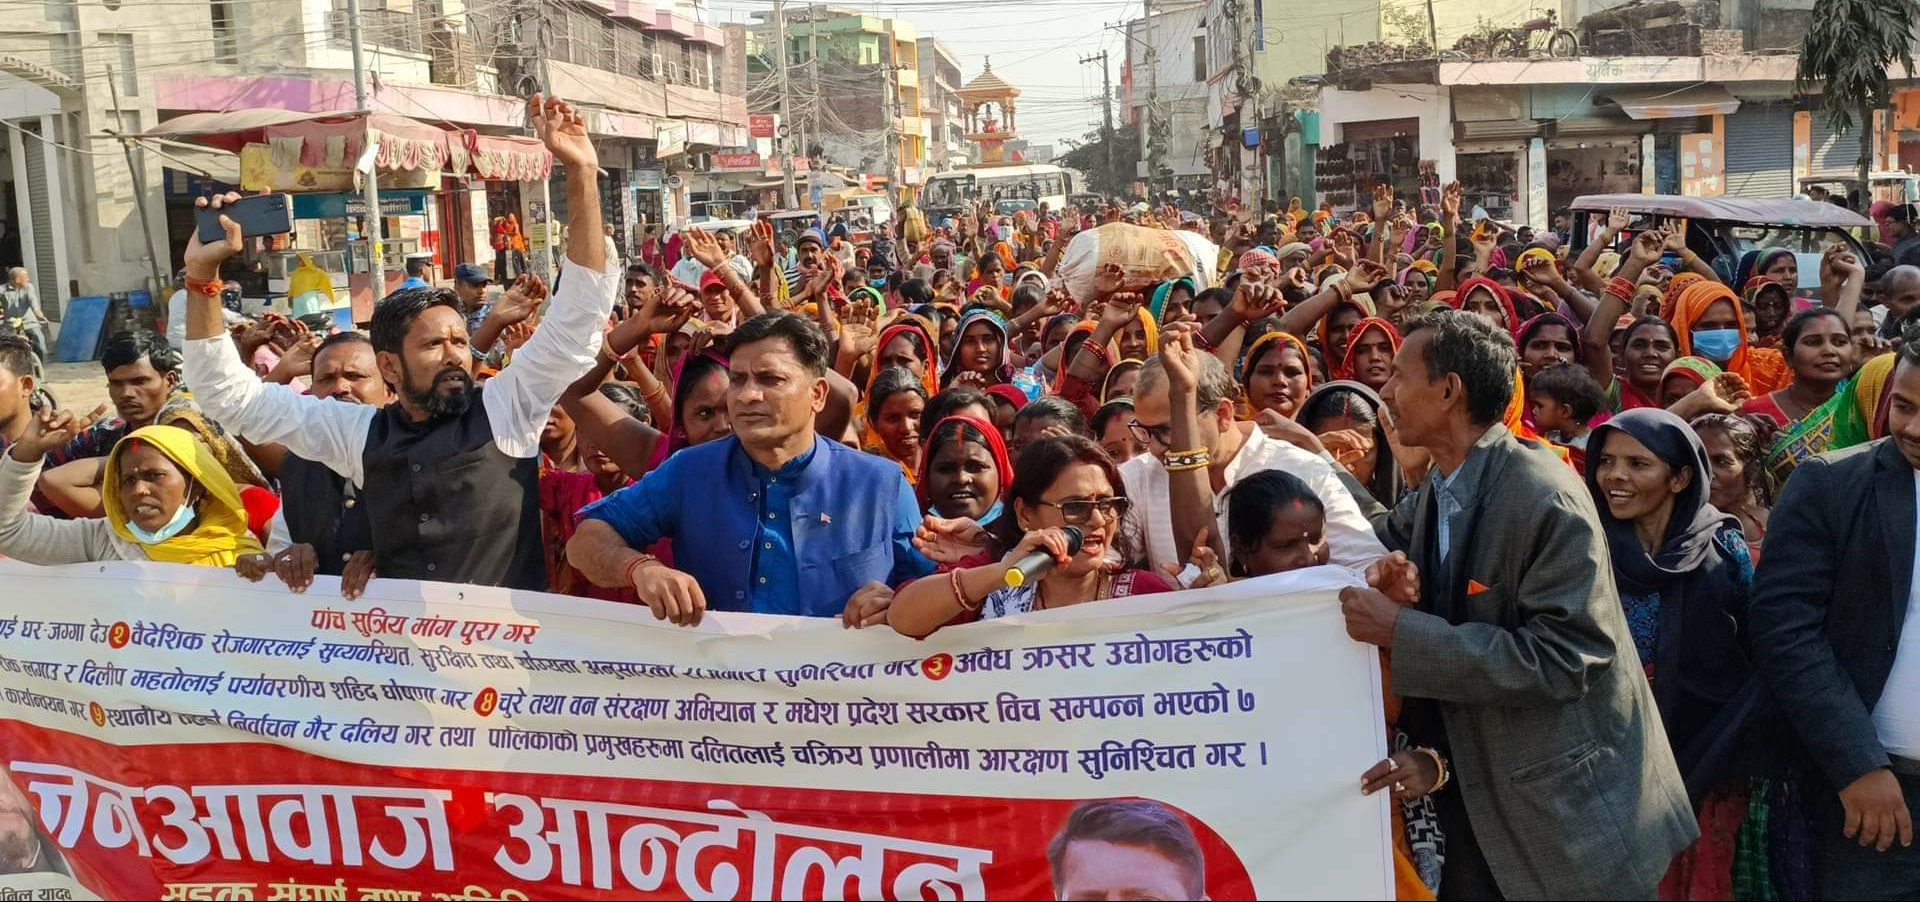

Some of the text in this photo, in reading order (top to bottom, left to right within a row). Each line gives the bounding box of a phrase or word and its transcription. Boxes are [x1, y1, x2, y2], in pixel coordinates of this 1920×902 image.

[131, 620, 206, 650] वैदेशिक
[211, 629, 317, 659] रोजगारलाई
[418, 644, 478, 672] सुरक्षित
[478, 653, 515, 669] तथा
[1022, 643, 1096, 671] क्रसर
[411, 614, 458, 638] मांग
[460, 620, 501, 645] पुरा
[503, 624, 540, 644] गर
[64, 665, 78, 683] र
[78, 659, 128, 687] दिलीप
[130, 667, 225, 695] महतोलाई
[329, 676, 378, 701] शहिद
[380, 679, 436, 704] घोषणा
[440, 689, 472, 710] गर
[498, 687, 527, 718] चुरे
[529, 694, 567, 715] तथा
[569, 696, 600, 716] वन
[603, 693, 670, 721] संरक्षण
[674, 693, 756, 723] अभियान
[763, 702, 779, 724] र
[846, 697, 898, 726] प्रदेश
[905, 701, 989, 724] सरकार
[996, 692, 1041, 723] विच
[1048, 694, 1145, 722] सम्पन्न
[1153, 682, 1230, 716] भएको
[1238, 689, 1255, 712] ७
[227, 709, 300, 738] निर्वाचन
[303, 715, 337, 742] गैर
[341, 717, 400, 744] दलिय
[405, 725, 434, 747] गर
[439, 727, 476, 747] तथा
[689, 736, 785, 766] दलितलाई
[790, 740, 863, 766] चक्रिय
[869, 741, 969, 769] प्रणालीमा
[976, 748, 1069, 776] आरक्षण
[1078, 738, 1197, 780] सुनिश्चित
[1204, 742, 1246, 767] गर
[484, 799, 993, 901] आन्दोलन
